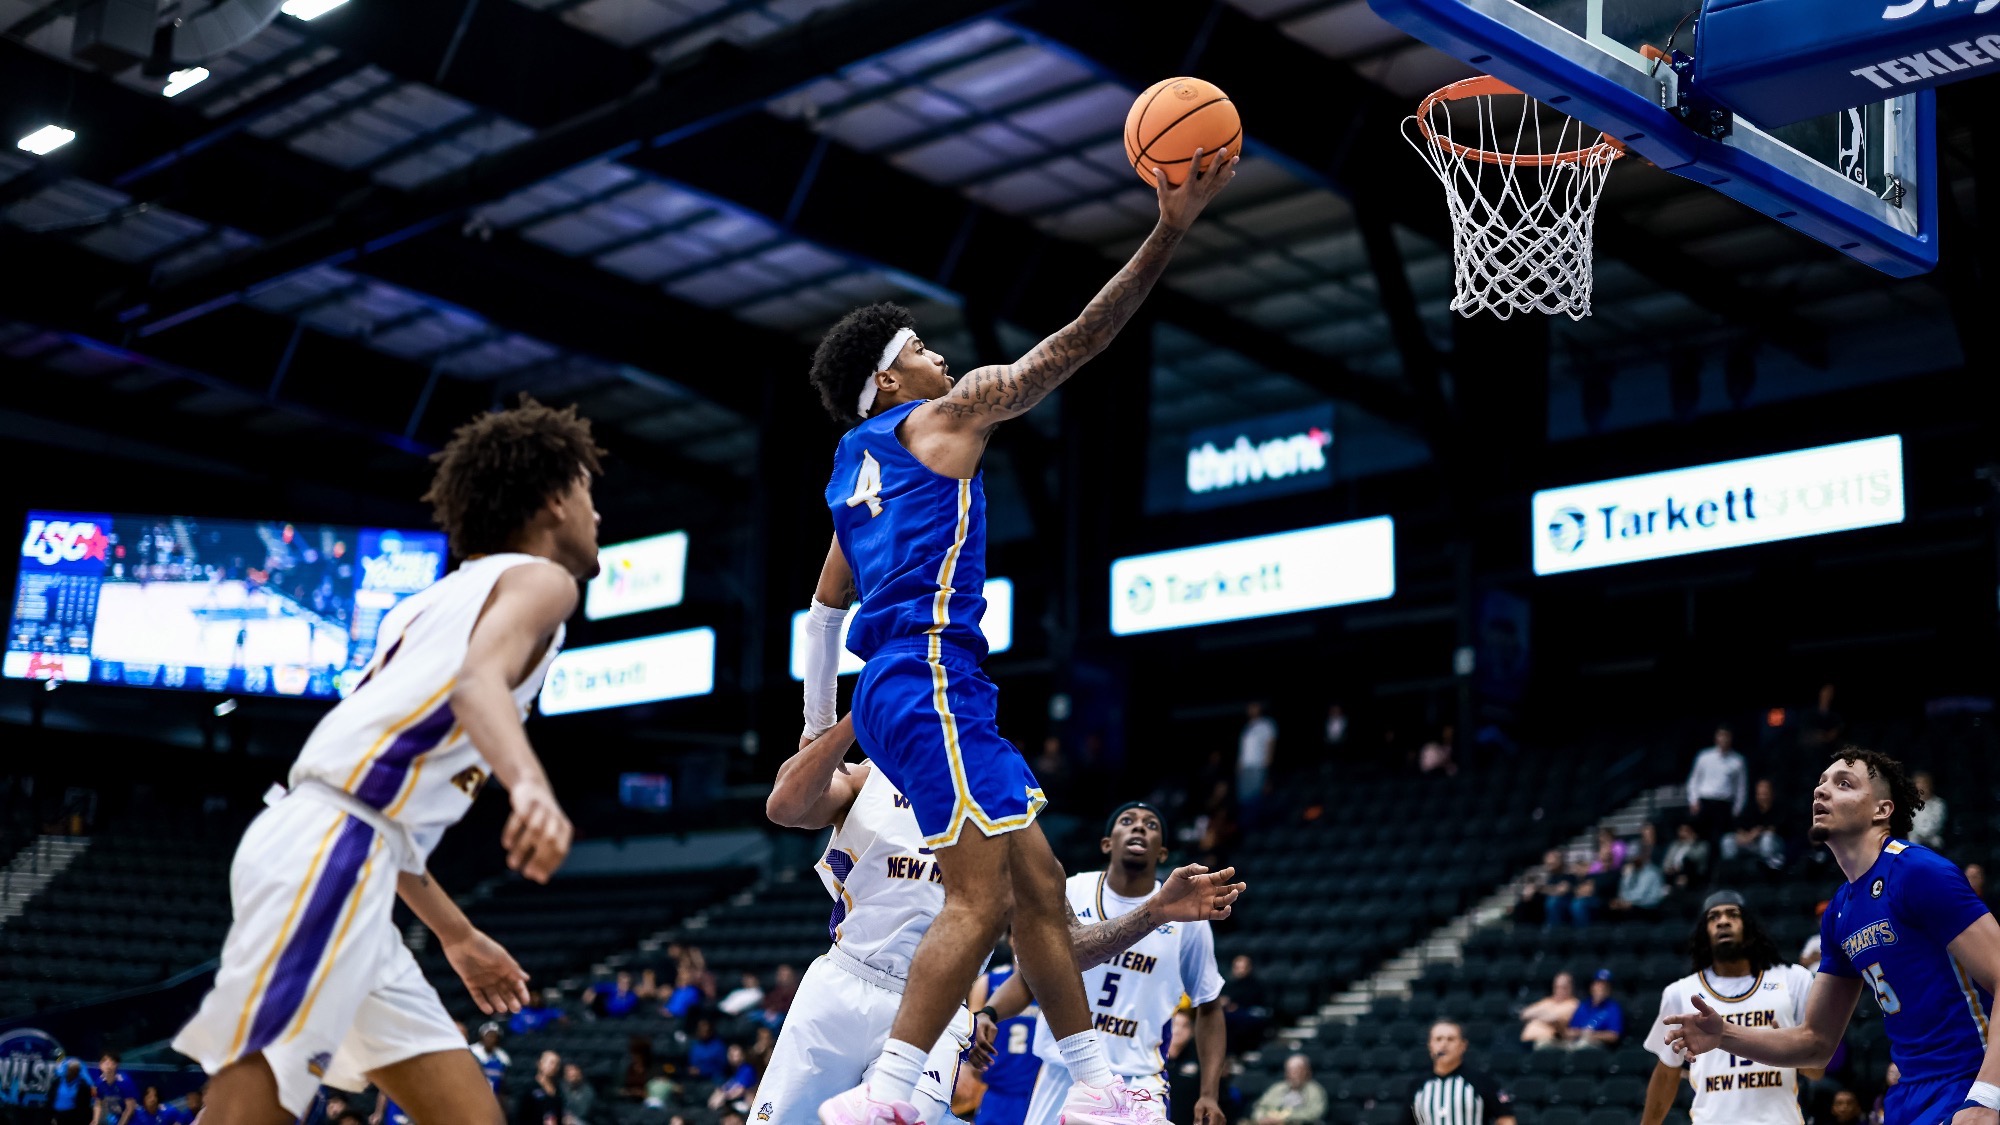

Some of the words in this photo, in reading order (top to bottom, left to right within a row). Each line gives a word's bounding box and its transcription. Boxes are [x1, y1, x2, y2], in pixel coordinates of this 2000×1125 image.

[846, 448, 884, 518] 4
[1187, 433, 1327, 493] thrivent
[1598, 487, 1757, 541] Tarkett
[22, 520, 96, 566] LSC
[1165, 562, 1284, 605] Tarkett
[887, 856, 926, 880] NEW
[1102, 951, 1157, 974] TERN
[1096, 971, 1122, 1008] 5
[1007, 1022, 1029, 1055] 2
[1705, 1074, 1735, 1093] NEW
[1738, 1070, 1783, 1090] MEXICO
